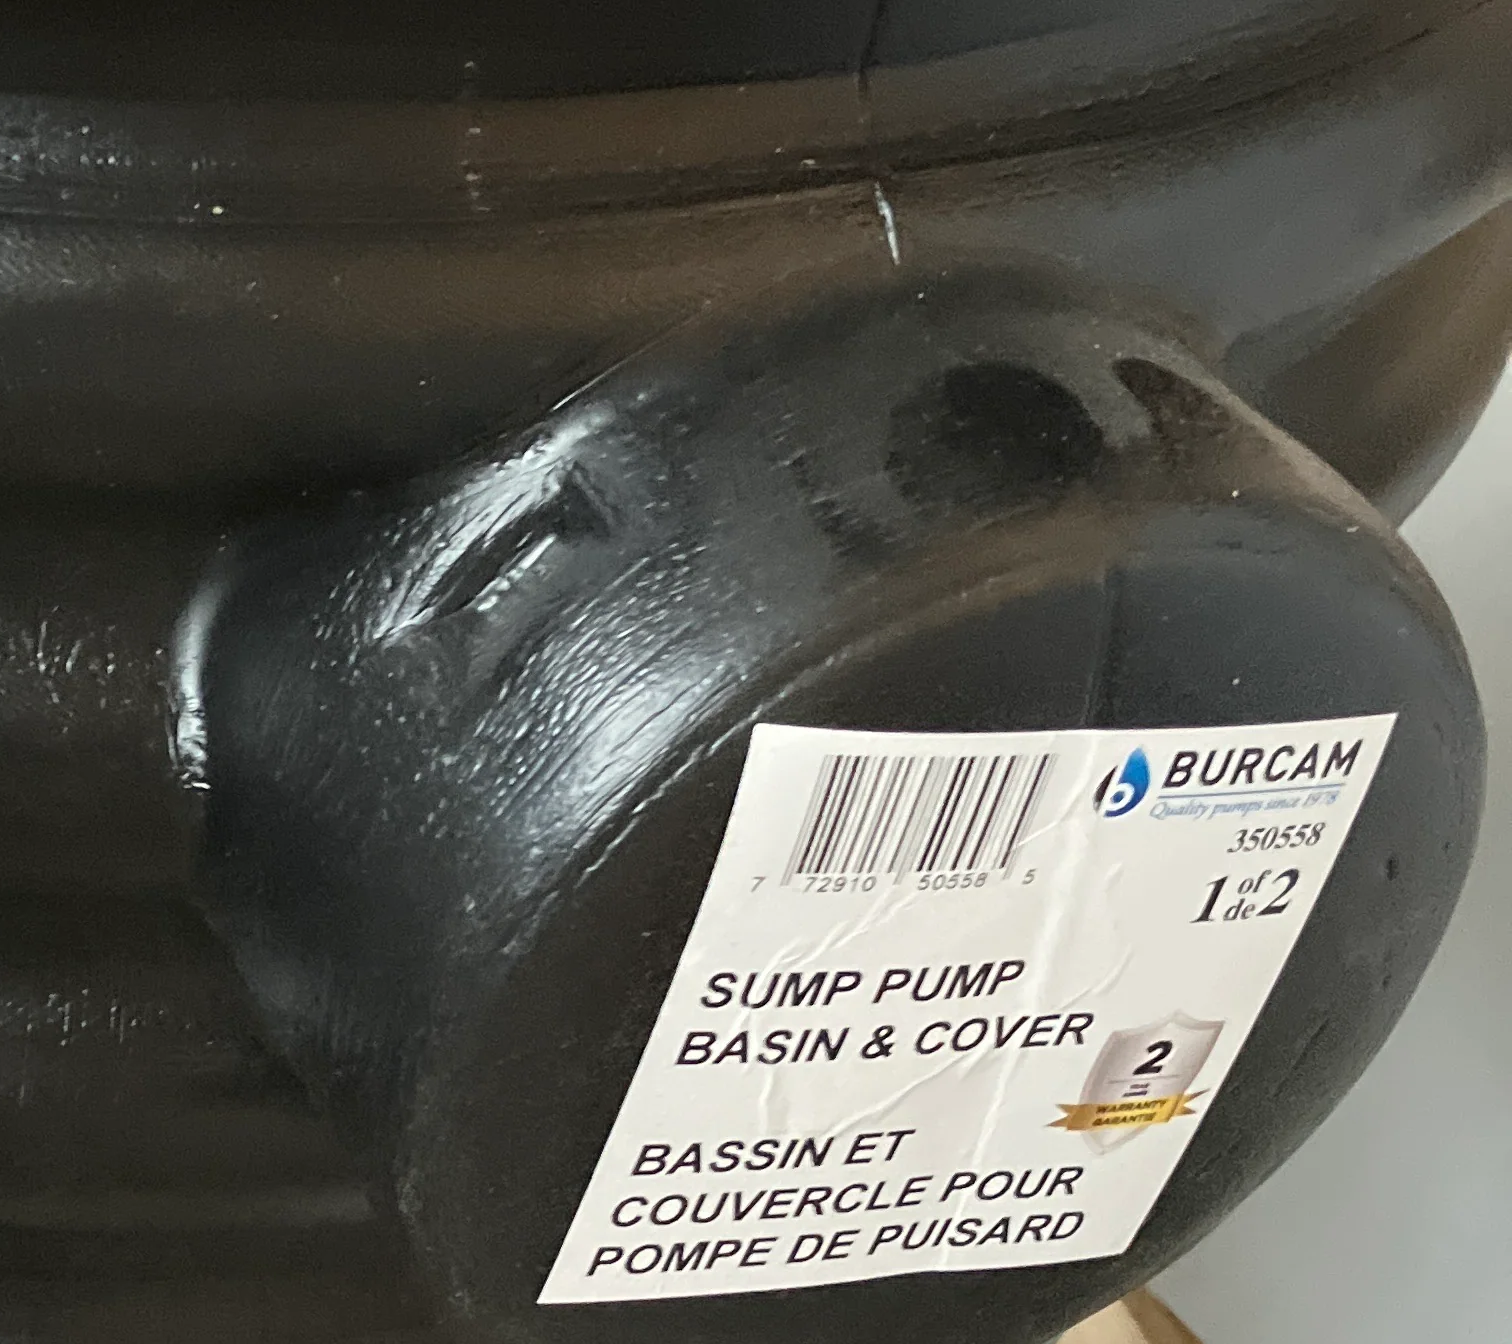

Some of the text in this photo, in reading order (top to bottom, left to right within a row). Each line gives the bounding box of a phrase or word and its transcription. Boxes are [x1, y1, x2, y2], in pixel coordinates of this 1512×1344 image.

[1162, 739, 1364, 789] BURCAM
[1149, 800, 1208, 820] Quality
[1208, 799, 1263, 820] pumps
[1265, 796, 1298, 810] since
[1227, 822, 1325, 853] 350558
[751, 868, 1037, 893] 7 72910 50558 5
[1189, 868, 1300, 924] 1 of 2
[1222, 898, 1256, 921] de
[700, 959, 1026, 1009] SUMP PUMP
[675, 1012, 1095, 1066] BASIN & COVER
[1132, 1040, 1174, 1076] 2
[631, 1129, 916, 1176] BASSIN ET
[611, 1166, 1084, 1228] COUVERCLE POUR
[587, 1211, 1084, 1277] POMPE DE PUISARD
